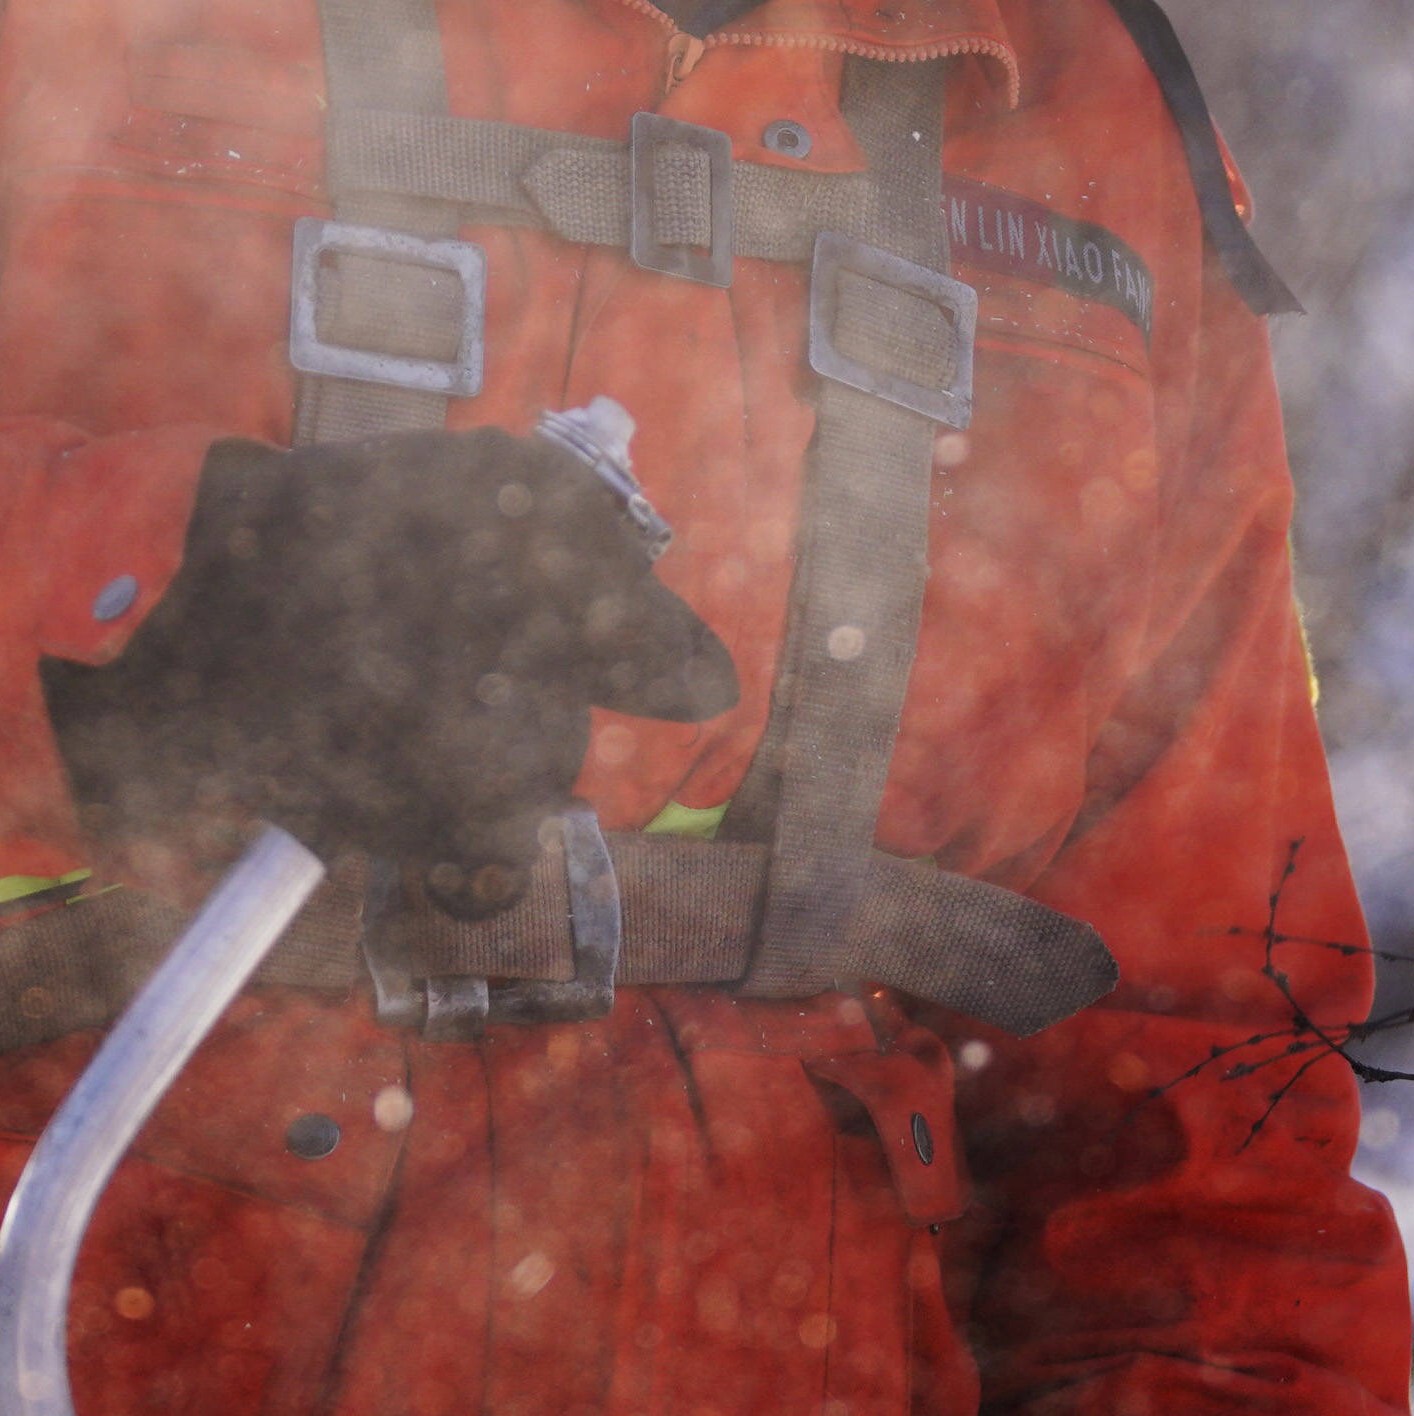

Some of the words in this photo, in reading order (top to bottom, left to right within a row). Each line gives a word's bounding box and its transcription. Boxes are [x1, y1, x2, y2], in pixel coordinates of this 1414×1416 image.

[940, 197, 968, 246] N
[977, 206, 1026, 260] LIN
[1034, 220, 1106, 285] XIAO
